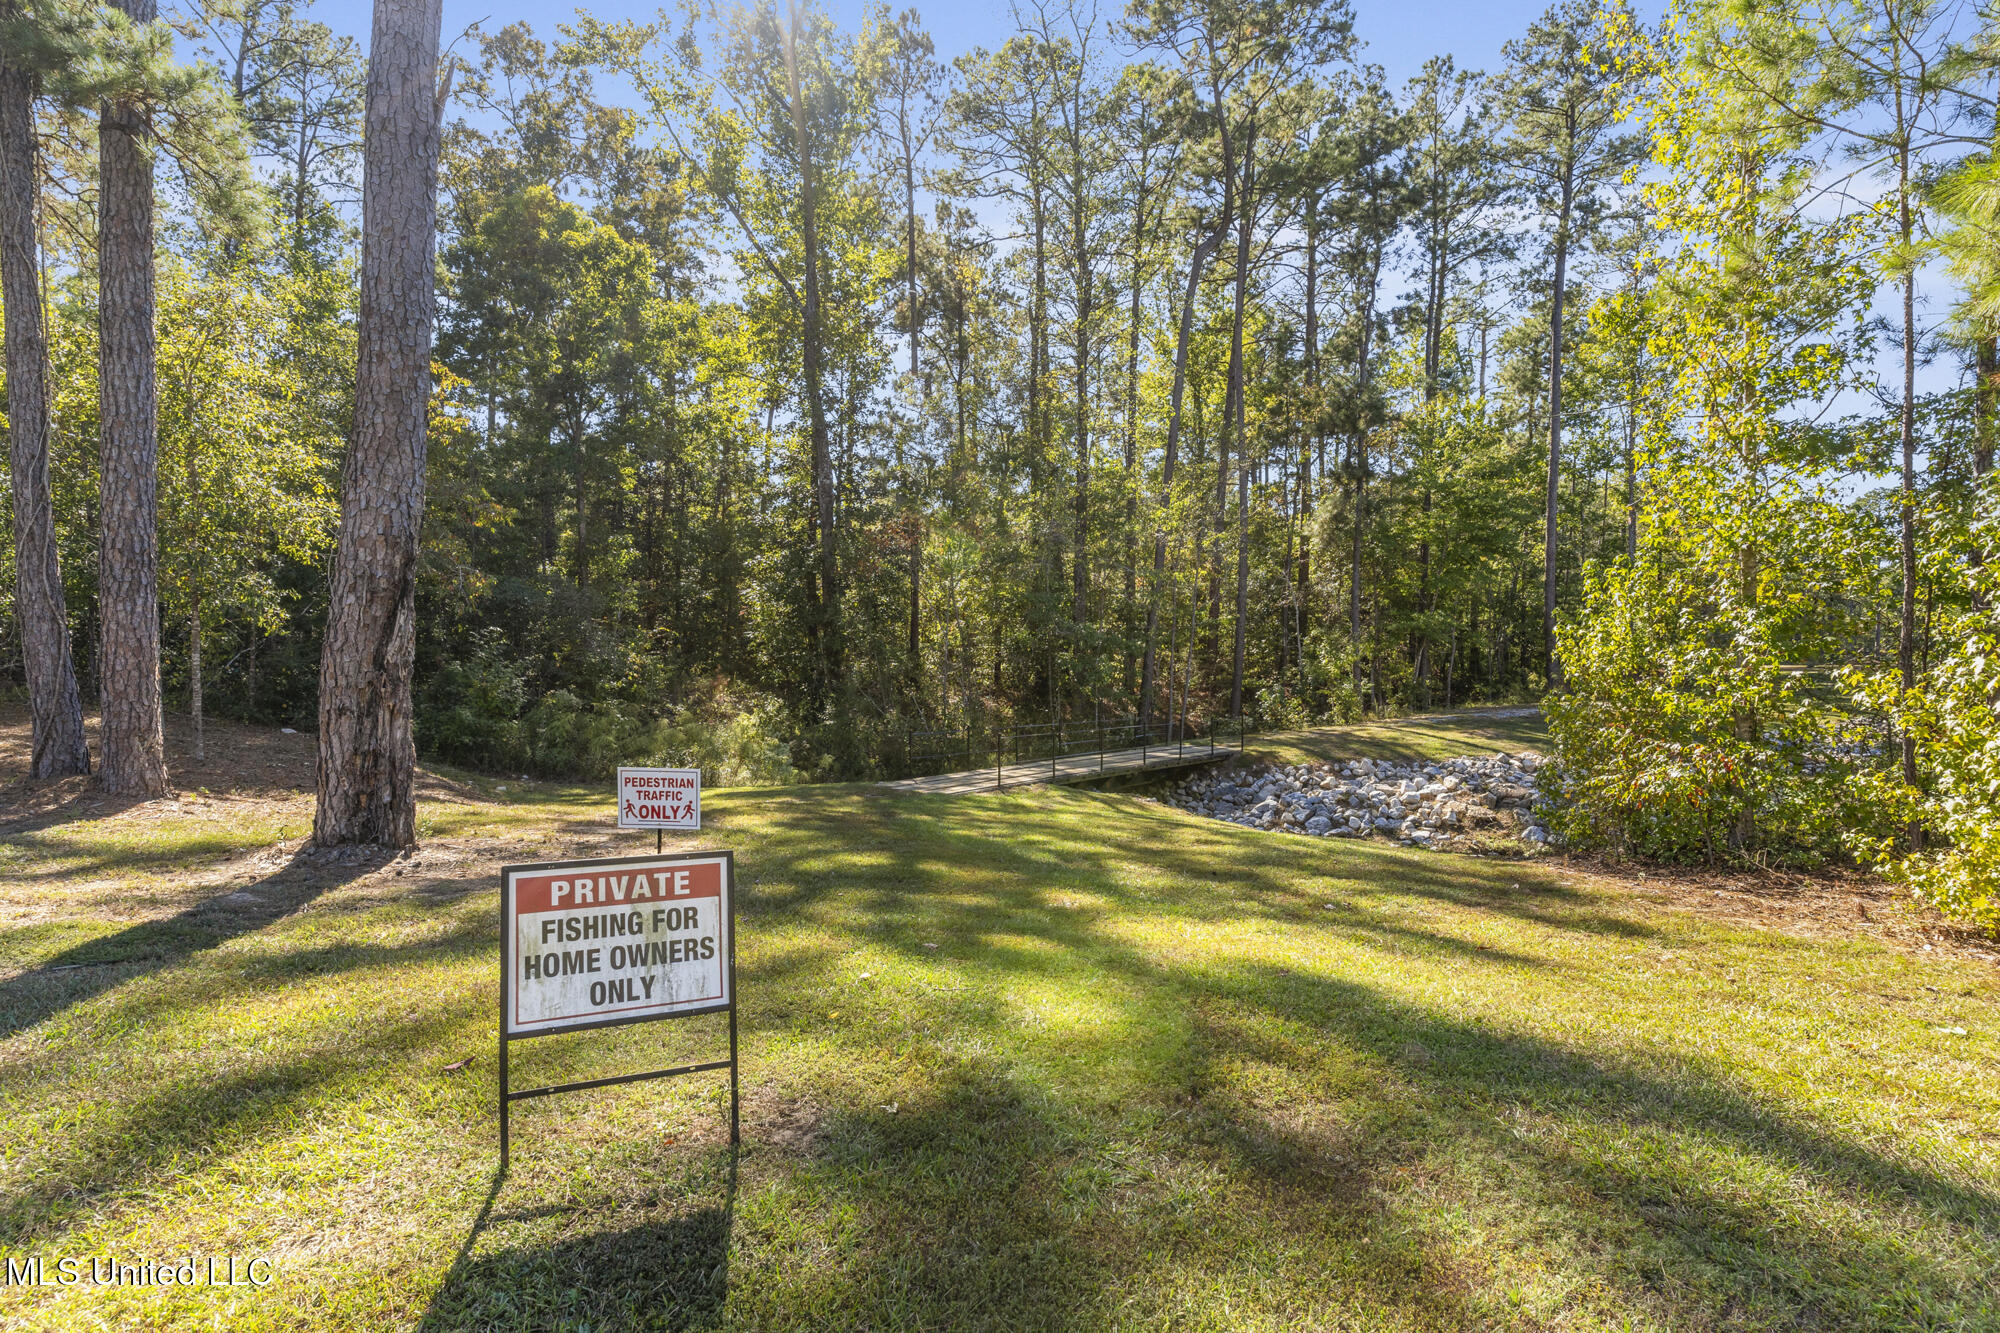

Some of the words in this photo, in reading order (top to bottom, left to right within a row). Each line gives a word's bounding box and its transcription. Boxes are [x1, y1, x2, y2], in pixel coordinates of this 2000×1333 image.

[624, 777, 694, 788] PEDESTRIAN
[636, 790, 683, 801] TRAFFIC
[638, 804, 681, 819] ONLY
[551, 871, 690, 906] PRIVATE
[541, 911, 643, 944] FISHING
[652, 906, 699, 933] FOR
[524, 948, 601, 980] HOME
[610, 936, 715, 970] OWNERS
[590, 975, 656, 1006] ONLY
